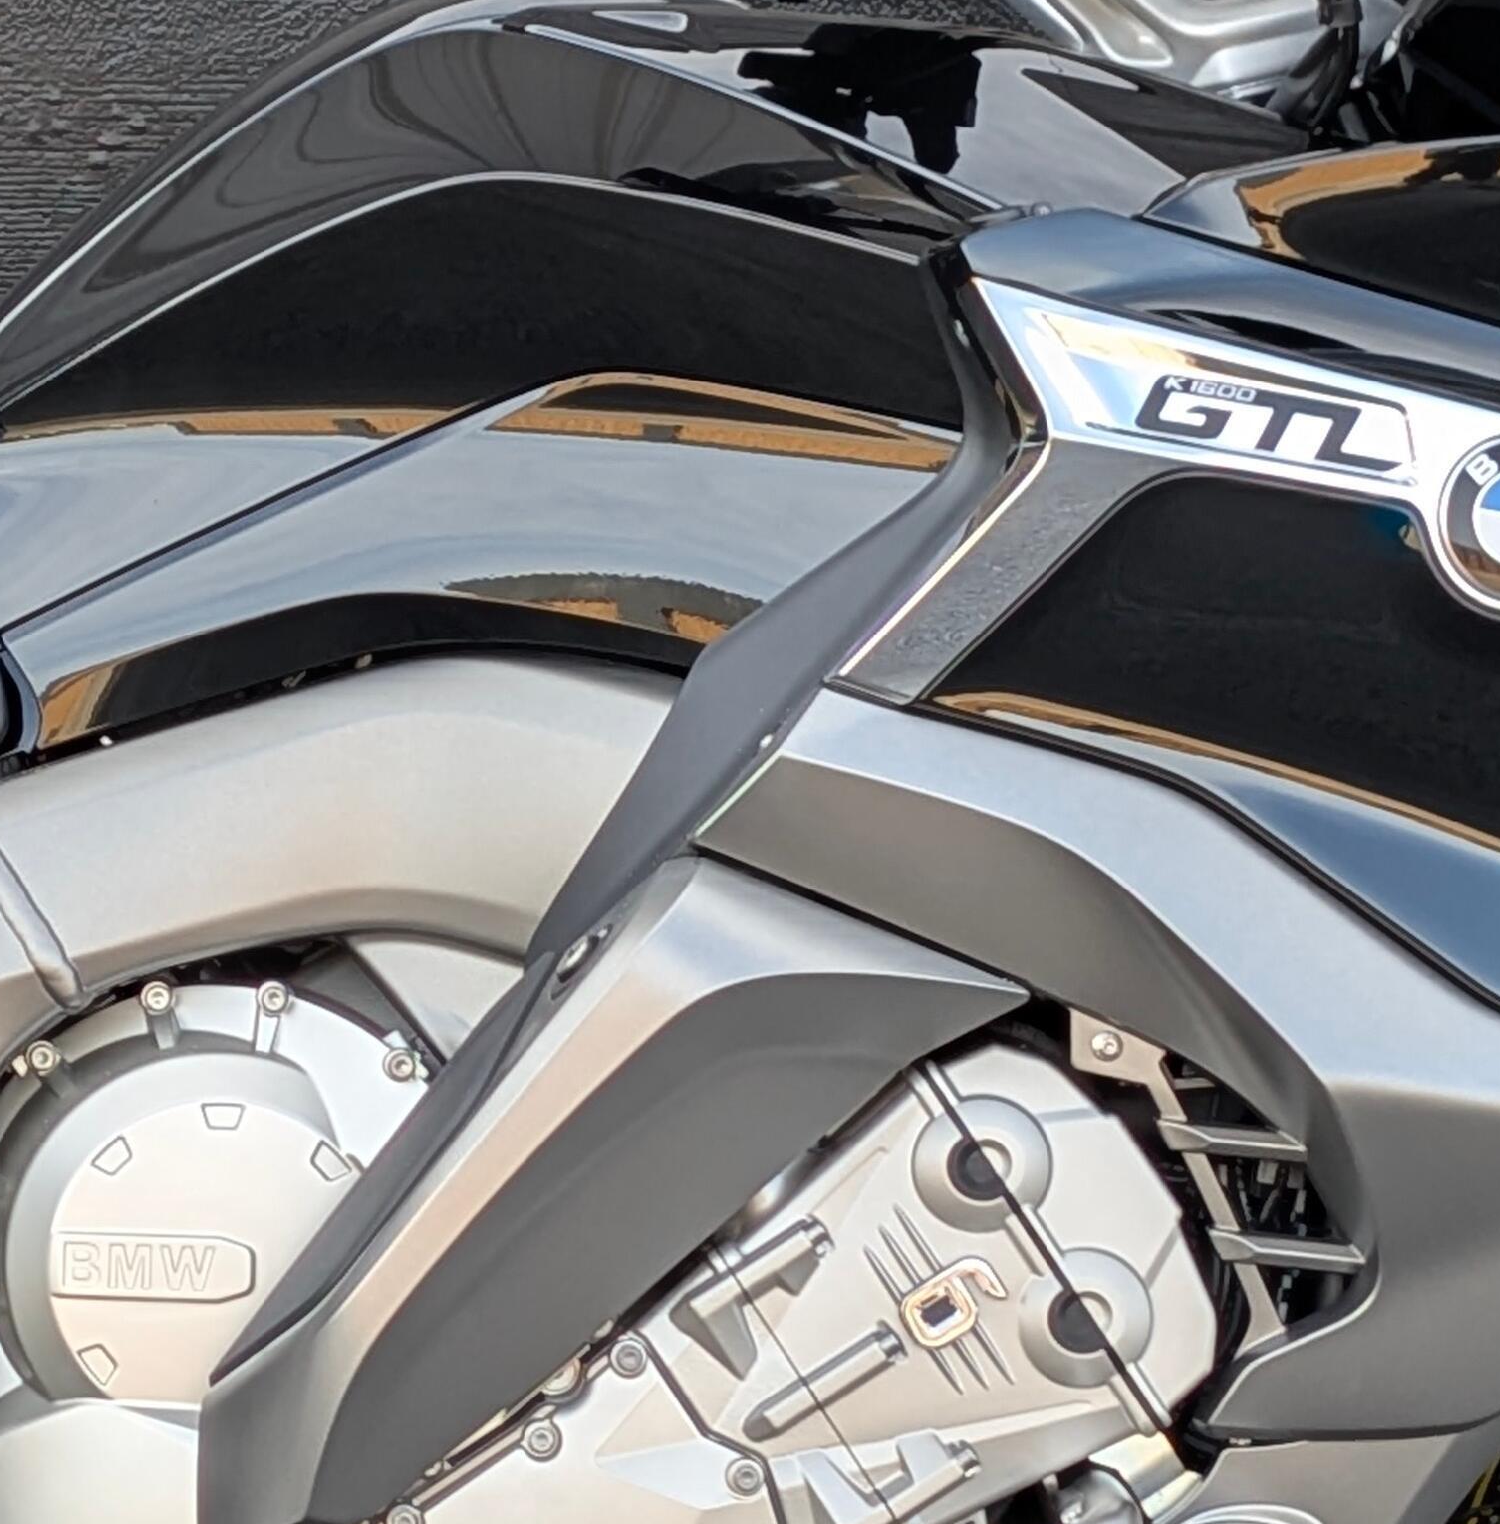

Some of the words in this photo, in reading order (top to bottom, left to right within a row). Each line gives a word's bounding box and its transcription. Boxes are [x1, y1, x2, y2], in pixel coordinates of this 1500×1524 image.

[1163, 375, 1184, 392] K
[1189, 379, 1257, 403] 1600
[1134, 374, 1402, 472] GTL
[62, 1241, 216, 1292] BMW
